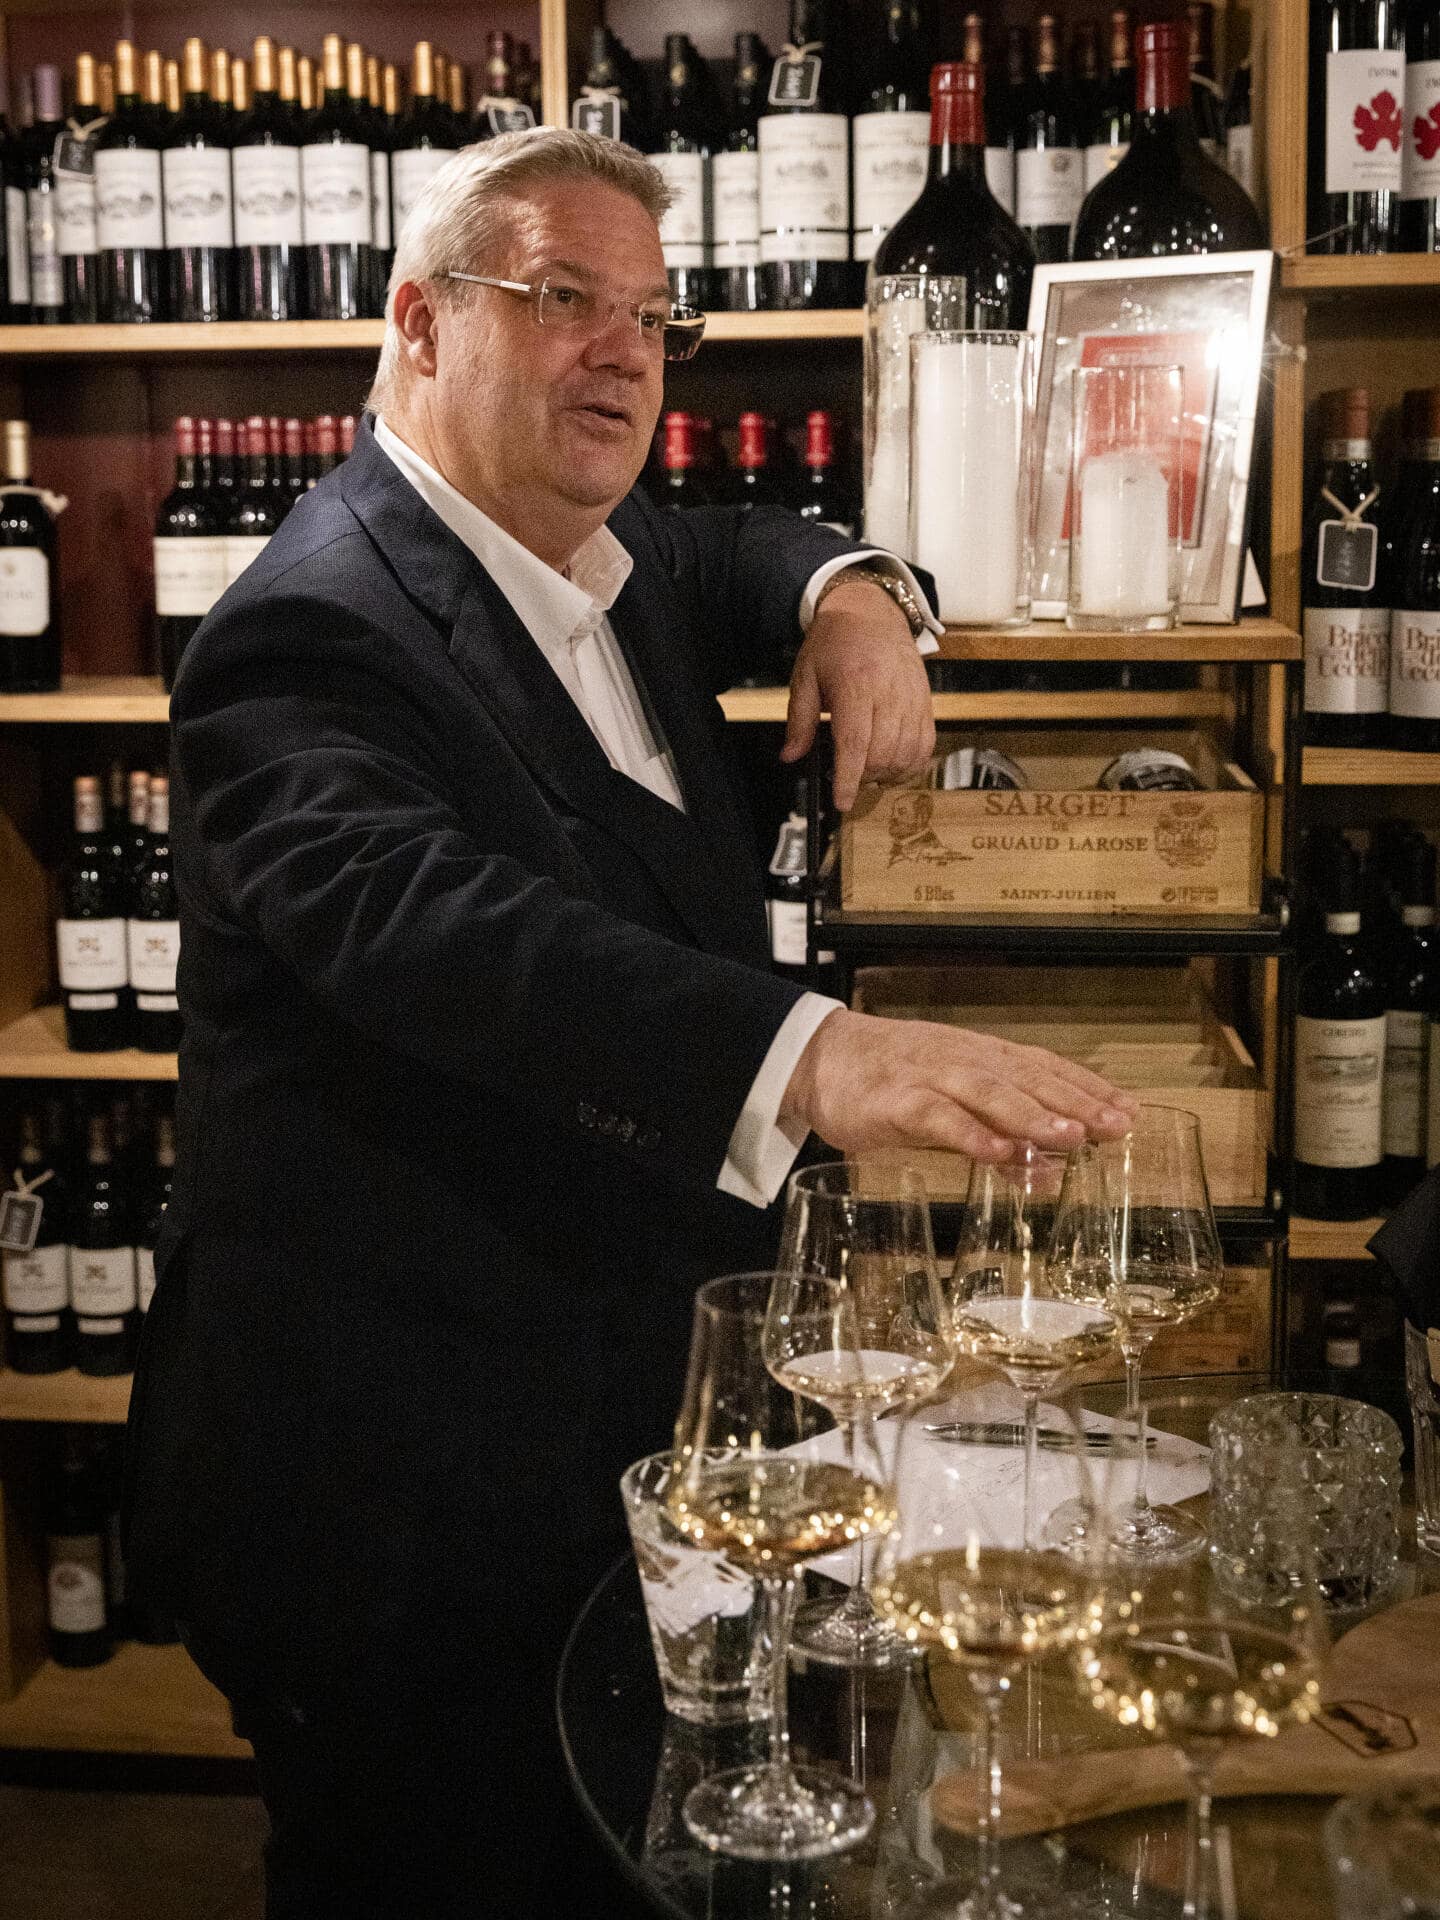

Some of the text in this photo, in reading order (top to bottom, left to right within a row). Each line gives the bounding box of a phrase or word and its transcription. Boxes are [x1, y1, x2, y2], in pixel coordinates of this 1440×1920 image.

[985, 792, 1136, 816] SARGET
[971, 836, 1149, 851] GRUAUD LAROSE
[1000, 889, 1117, 900] SAINT-JULIEN
